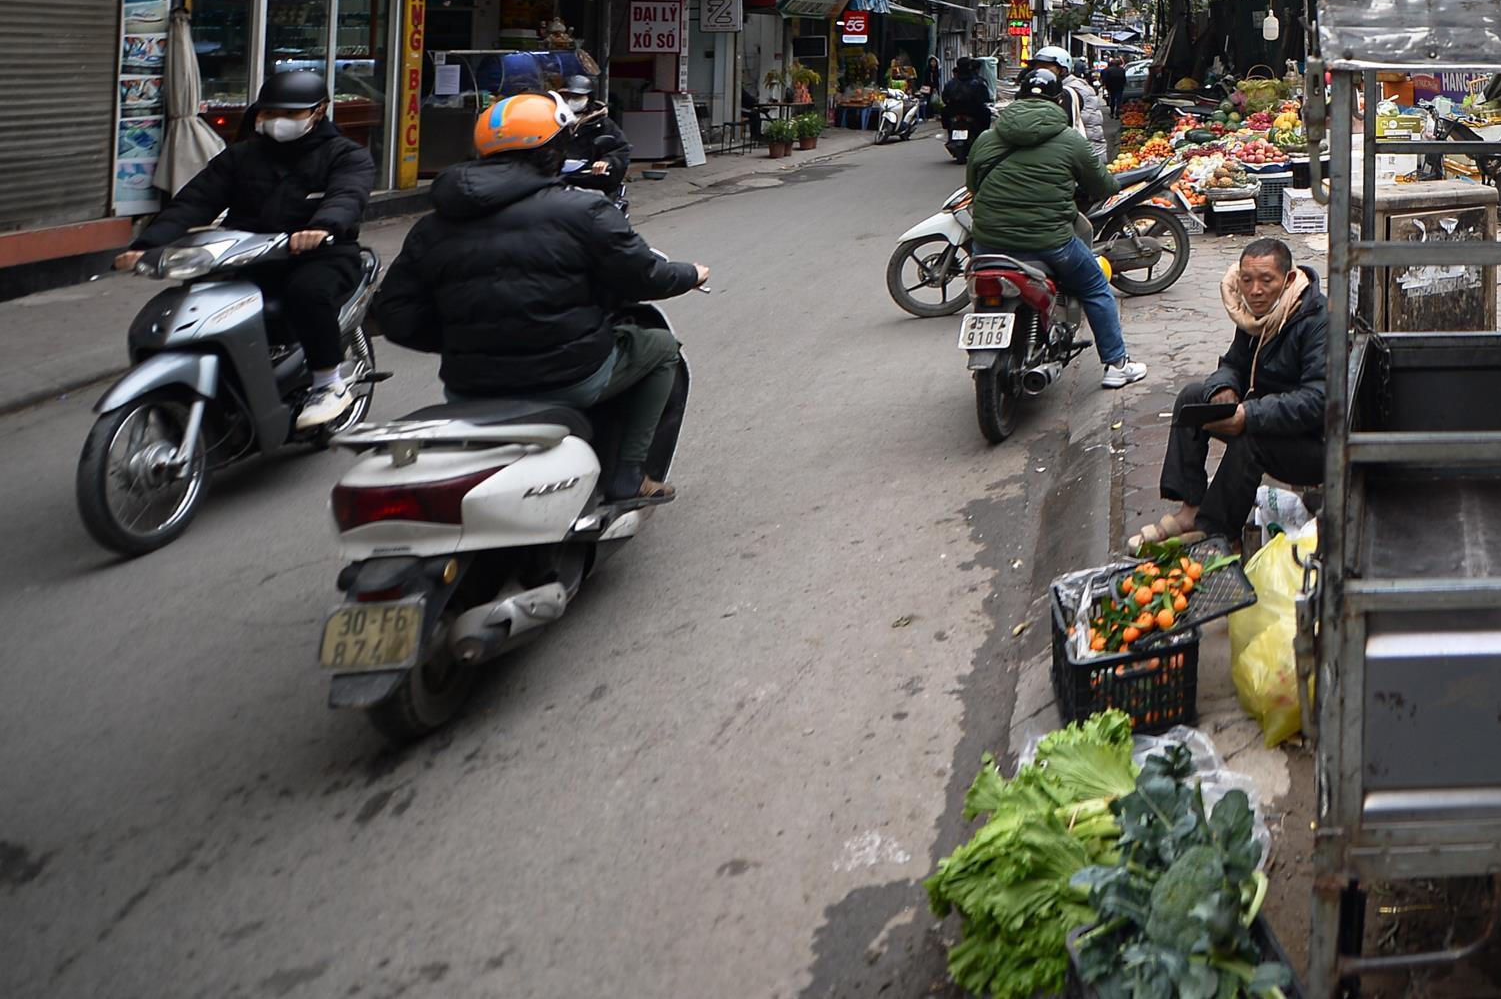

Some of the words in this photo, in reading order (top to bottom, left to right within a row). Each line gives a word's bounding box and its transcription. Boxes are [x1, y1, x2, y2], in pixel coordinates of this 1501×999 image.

[633, 5, 657, 26] ĐẠI
[662, 3, 677, 22] LÝ
[845, 19, 865, 32] 5G
[633, 26, 652, 49] XỔ
[656, 27, 676, 49] SỐ
[405, 68, 420, 146] BẠC
[966, 331, 1003, 346] 9109
[336, 608, 408, 637] 30-F6
[331, 636, 407, 666] 874
